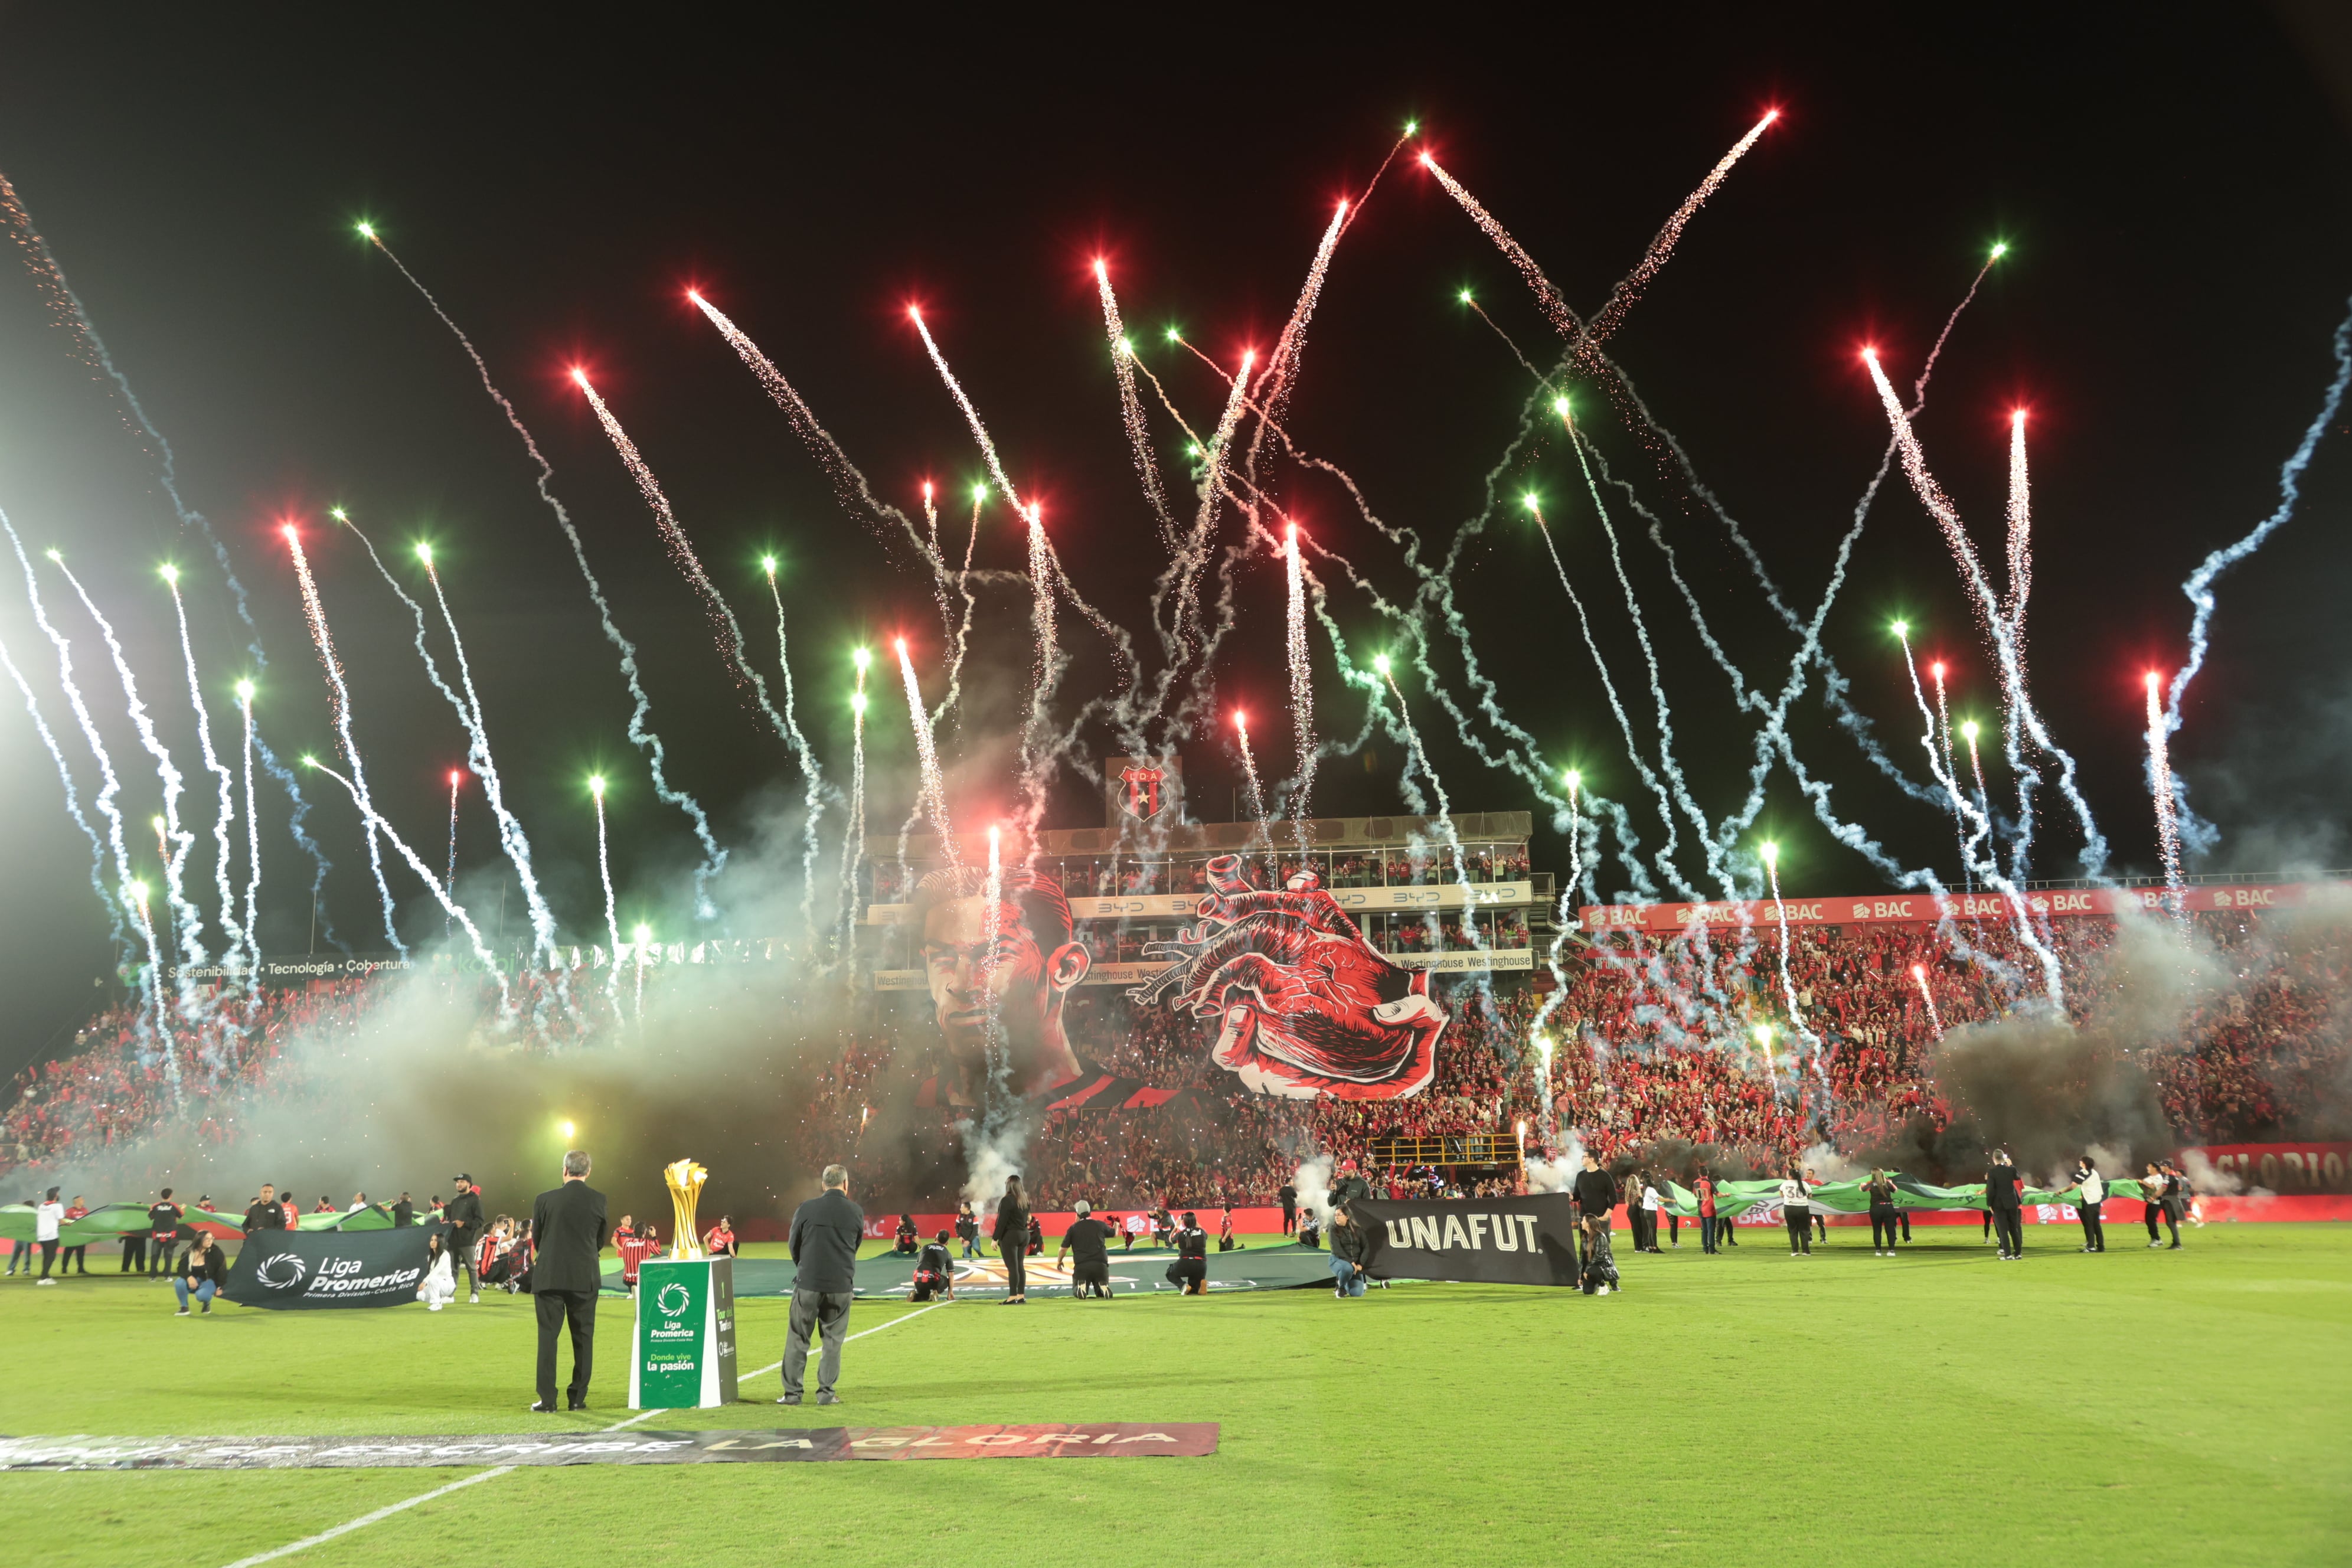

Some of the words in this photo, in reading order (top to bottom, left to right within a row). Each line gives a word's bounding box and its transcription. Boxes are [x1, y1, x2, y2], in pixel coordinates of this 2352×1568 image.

[1335, 895, 1366, 904] YD
[1394, 892, 1440, 902] BYD
[2053, 894, 2092, 910] BAC
[2236, 888, 2276, 906] BAC
[1098, 903, 1144, 913] BYD
[1785, 904, 1823, 920] BAC
[1874, 901, 1912, 917] BAC
[1964, 898, 2002, 914] BAC
[1610, 909, 1647, 925] BAC
[1696, 906, 1734, 923] BAC
[168, 964, 256, 979] Sostenibilidad
[267, 961, 334, 976] Tecnología
[347, 960, 410, 973] Cobertura
[863, 1219, 884, 1236] AC
[318, 1257, 362, 1278] Liga
[308, 1268, 420, 1292] Promerica
[398, 1282, 414, 1290] Rica
[651, 1329, 694, 1338] Promerica
[664, 1321, 681, 1331] Liga
[647, 1361, 657, 1371] la
[660, 1360, 694, 1373] pasión
[313, 1440, 694, 1456] ESCRIBE
[703, 1439, 814, 1451] LA
[850, 1433, 1179, 1447] GLORIA
